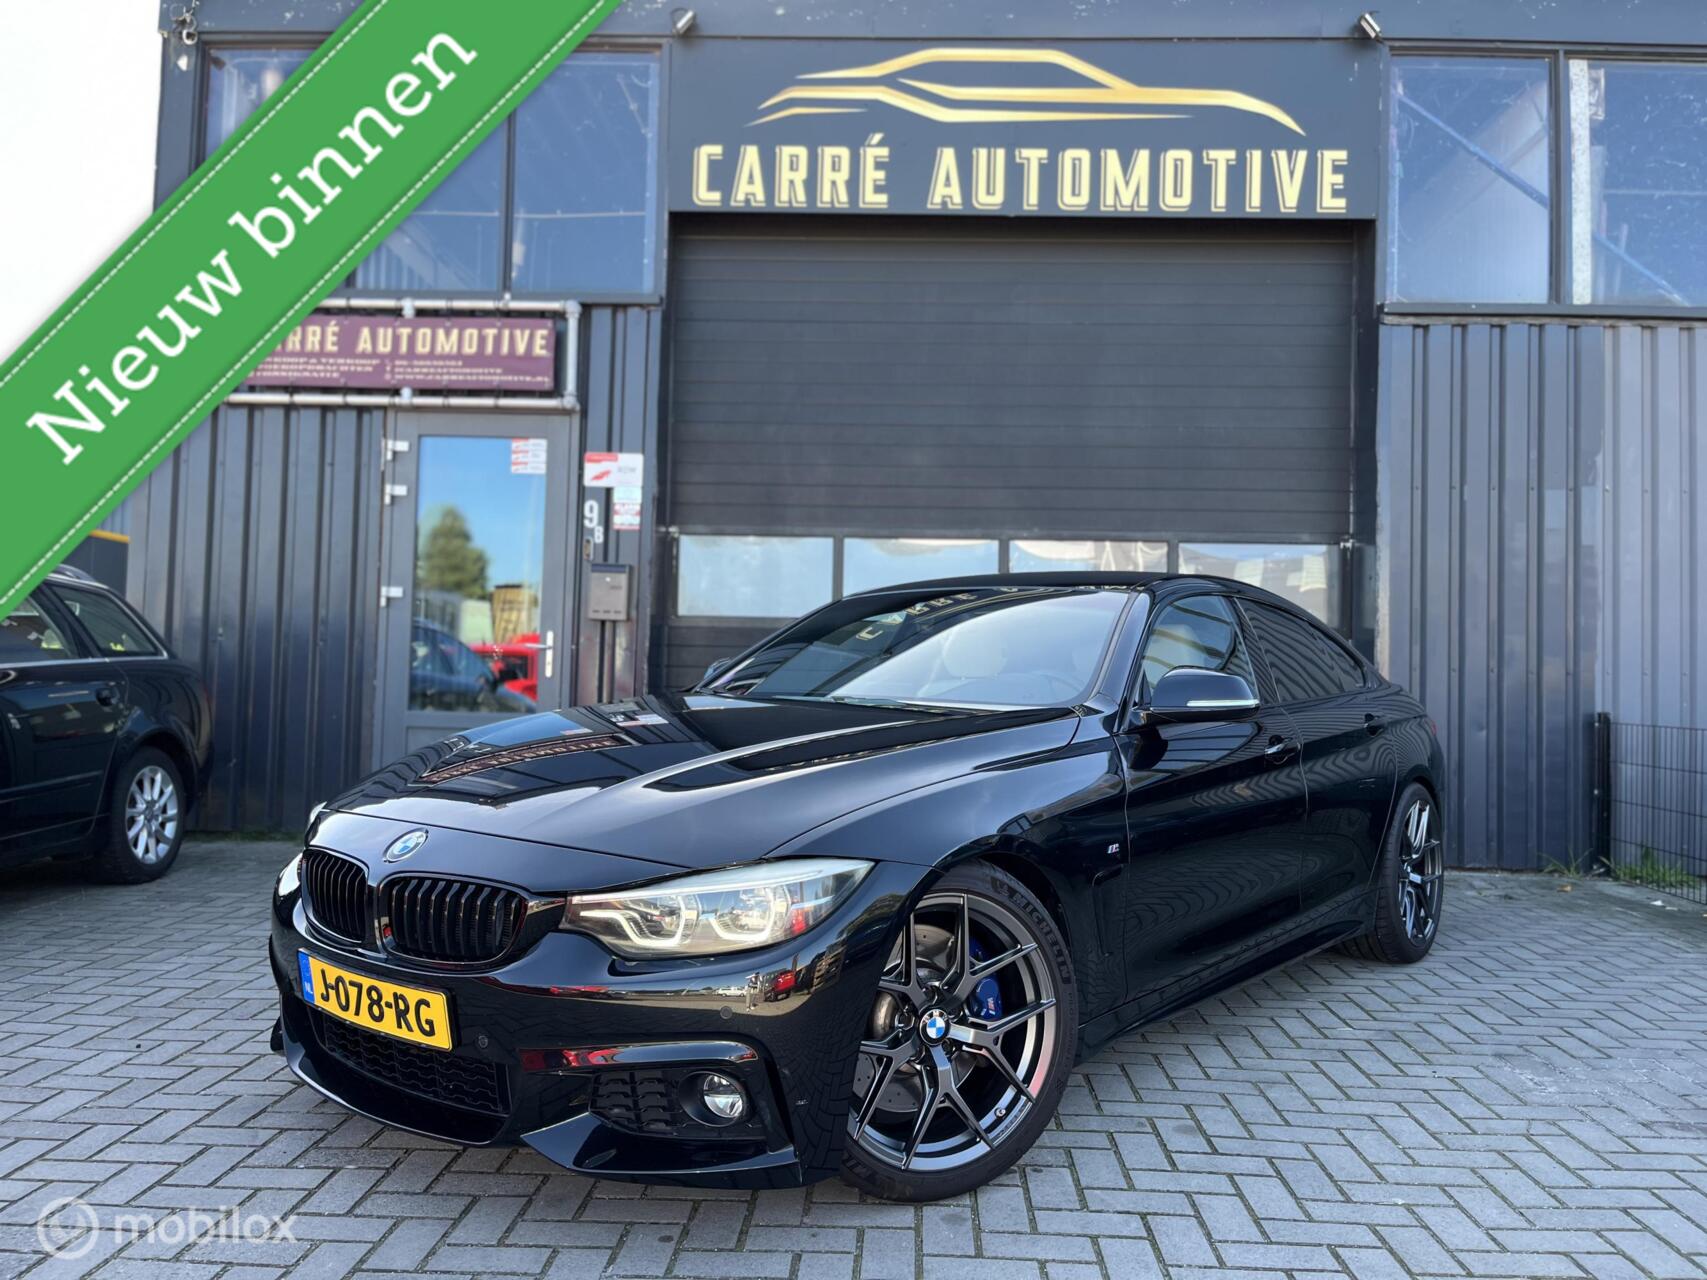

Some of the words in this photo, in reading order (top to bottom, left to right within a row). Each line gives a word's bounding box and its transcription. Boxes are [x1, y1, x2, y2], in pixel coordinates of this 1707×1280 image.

[692, 133, 890, 208] CARRÉ
[926, 146, 1349, 214] AUTOMOTIVE
[275, 320, 340, 353] RRÉ
[355, 325, 549, 357] AUTOMOTIVE
[583, 500, 599, 528] 9
[320, 967, 436, 1038] J-078-RG
